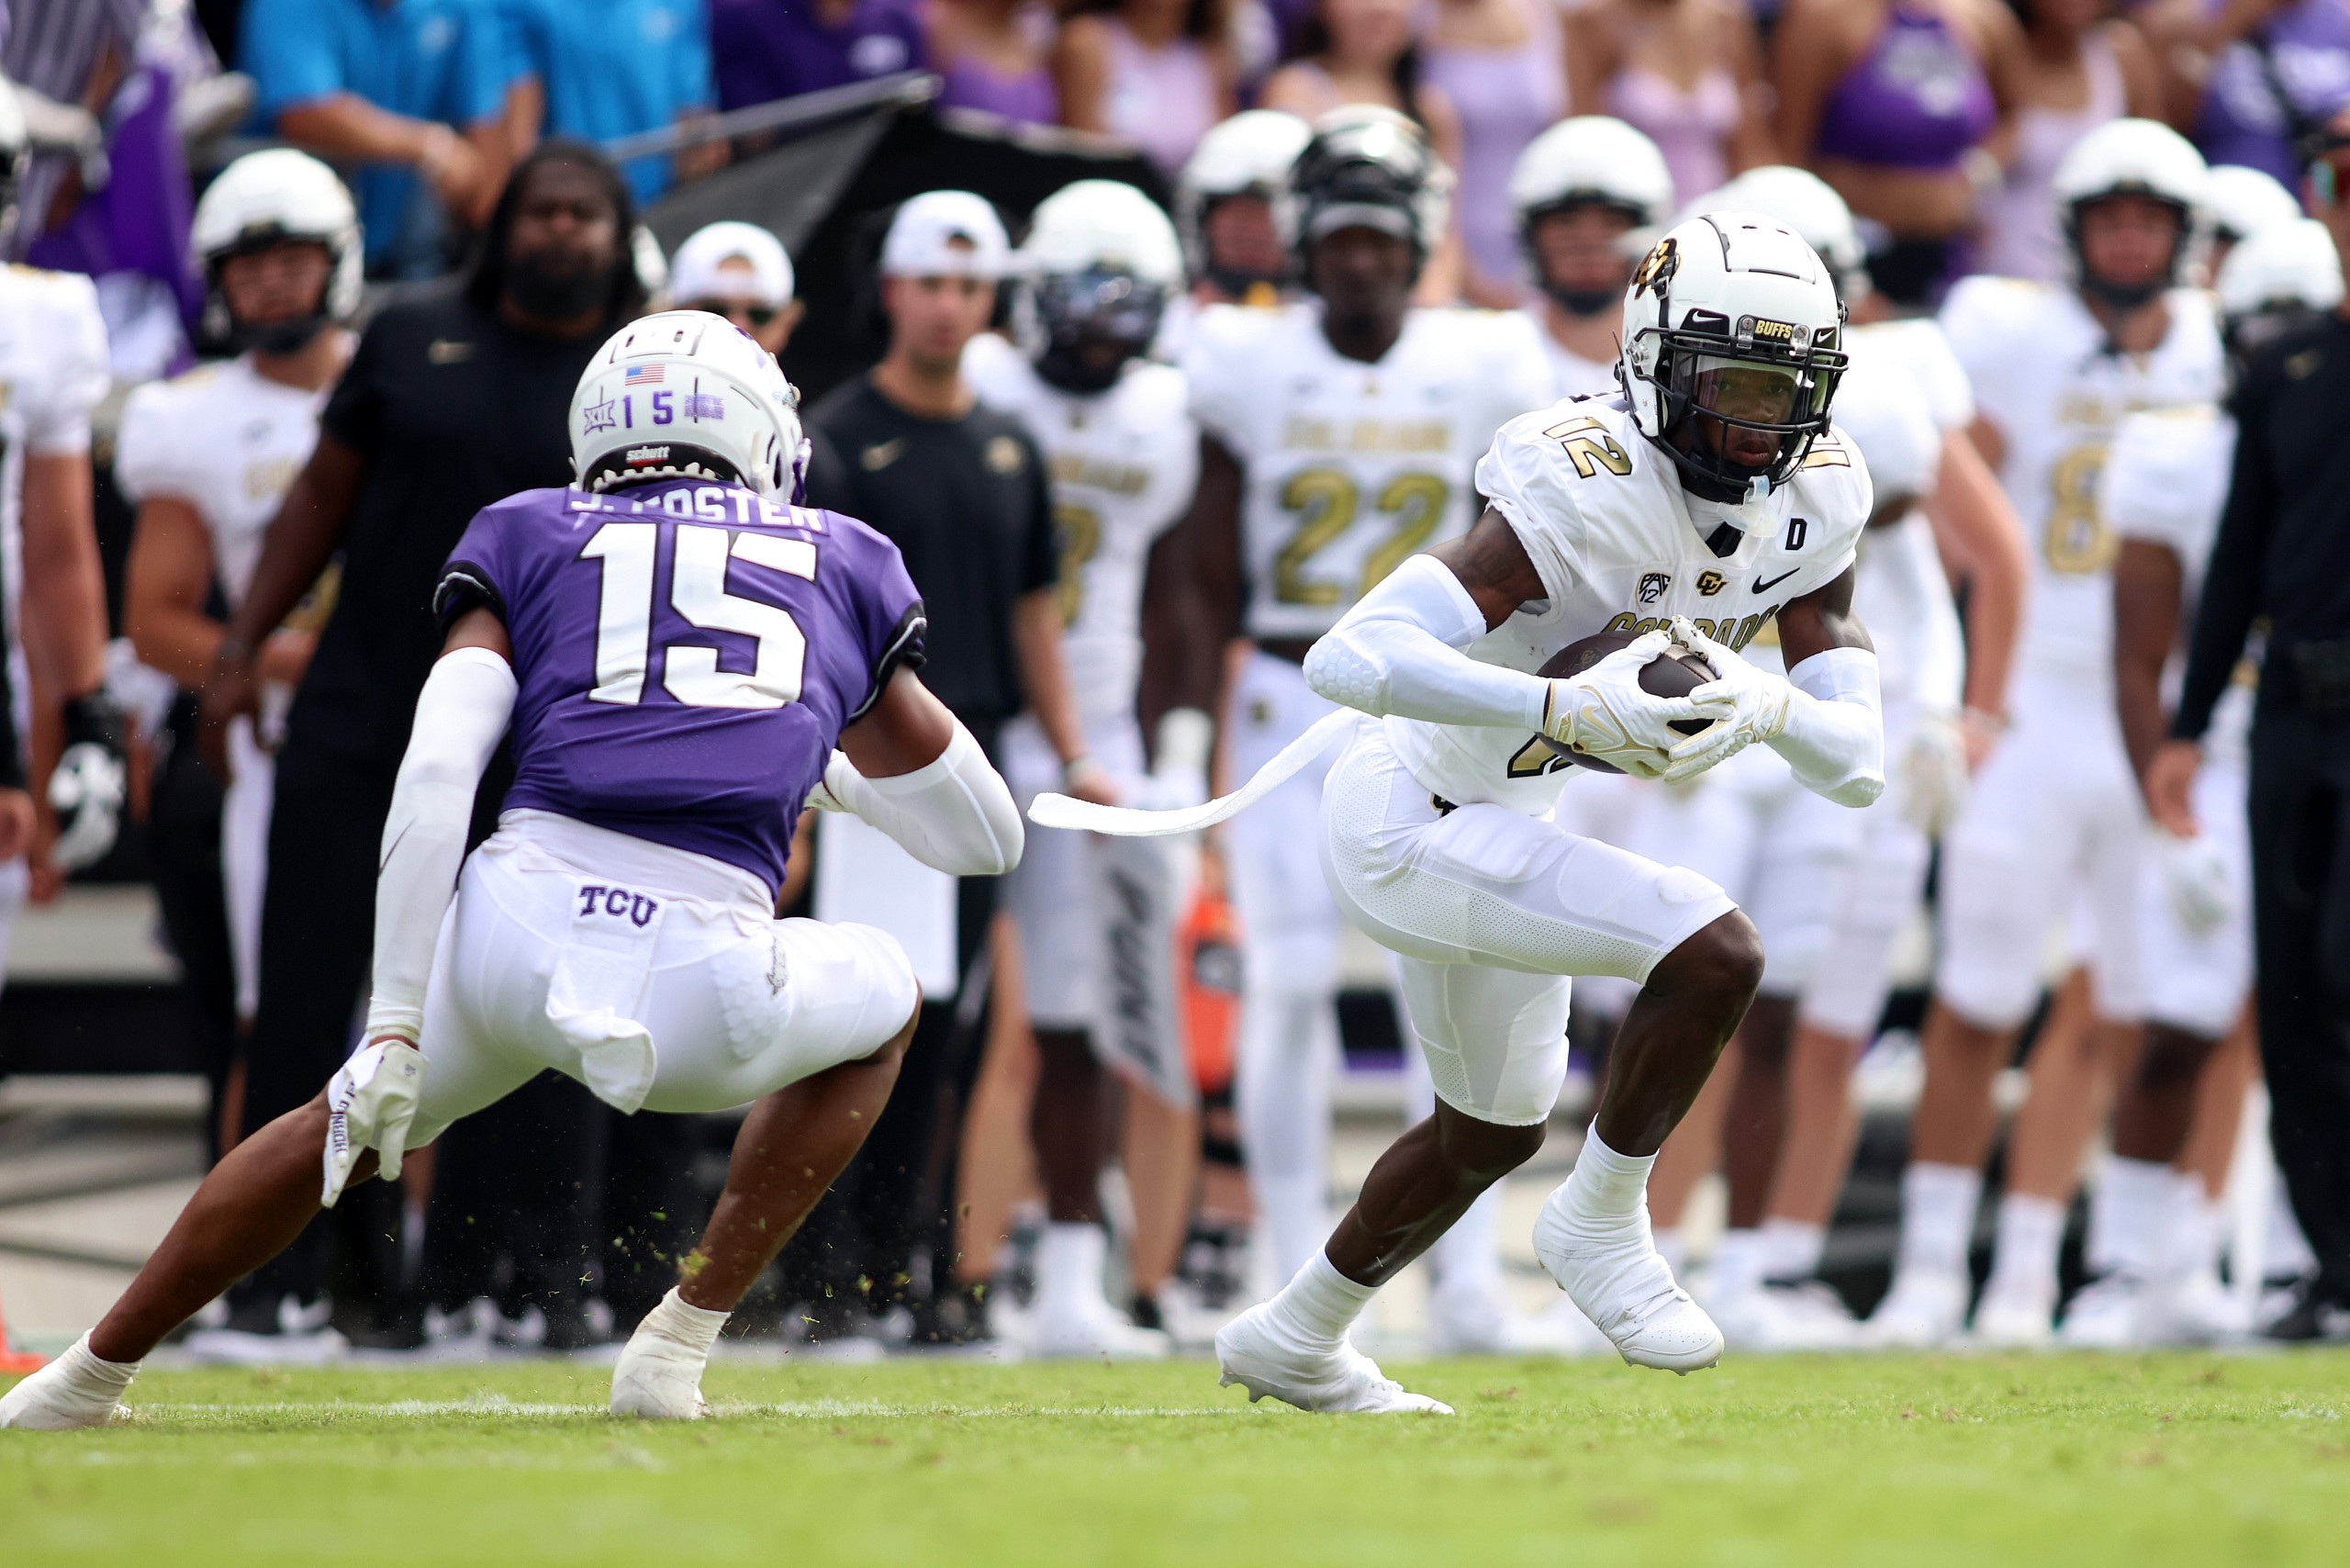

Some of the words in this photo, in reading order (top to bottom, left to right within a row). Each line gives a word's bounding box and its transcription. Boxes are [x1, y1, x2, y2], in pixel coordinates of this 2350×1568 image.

[1754, 319, 1793, 339] BUFFS
[1541, 415, 1633, 479] 12
[1276, 467, 1449, 607] 22
[1785, 517, 1807, 551] D
[1639, 572, 1672, 597] PAC
[1639, 588, 1660, 604] 12
[1695, 569, 1729, 597] CU
[579, 521, 818, 709] 15
[578, 884, 658, 929] TCU
